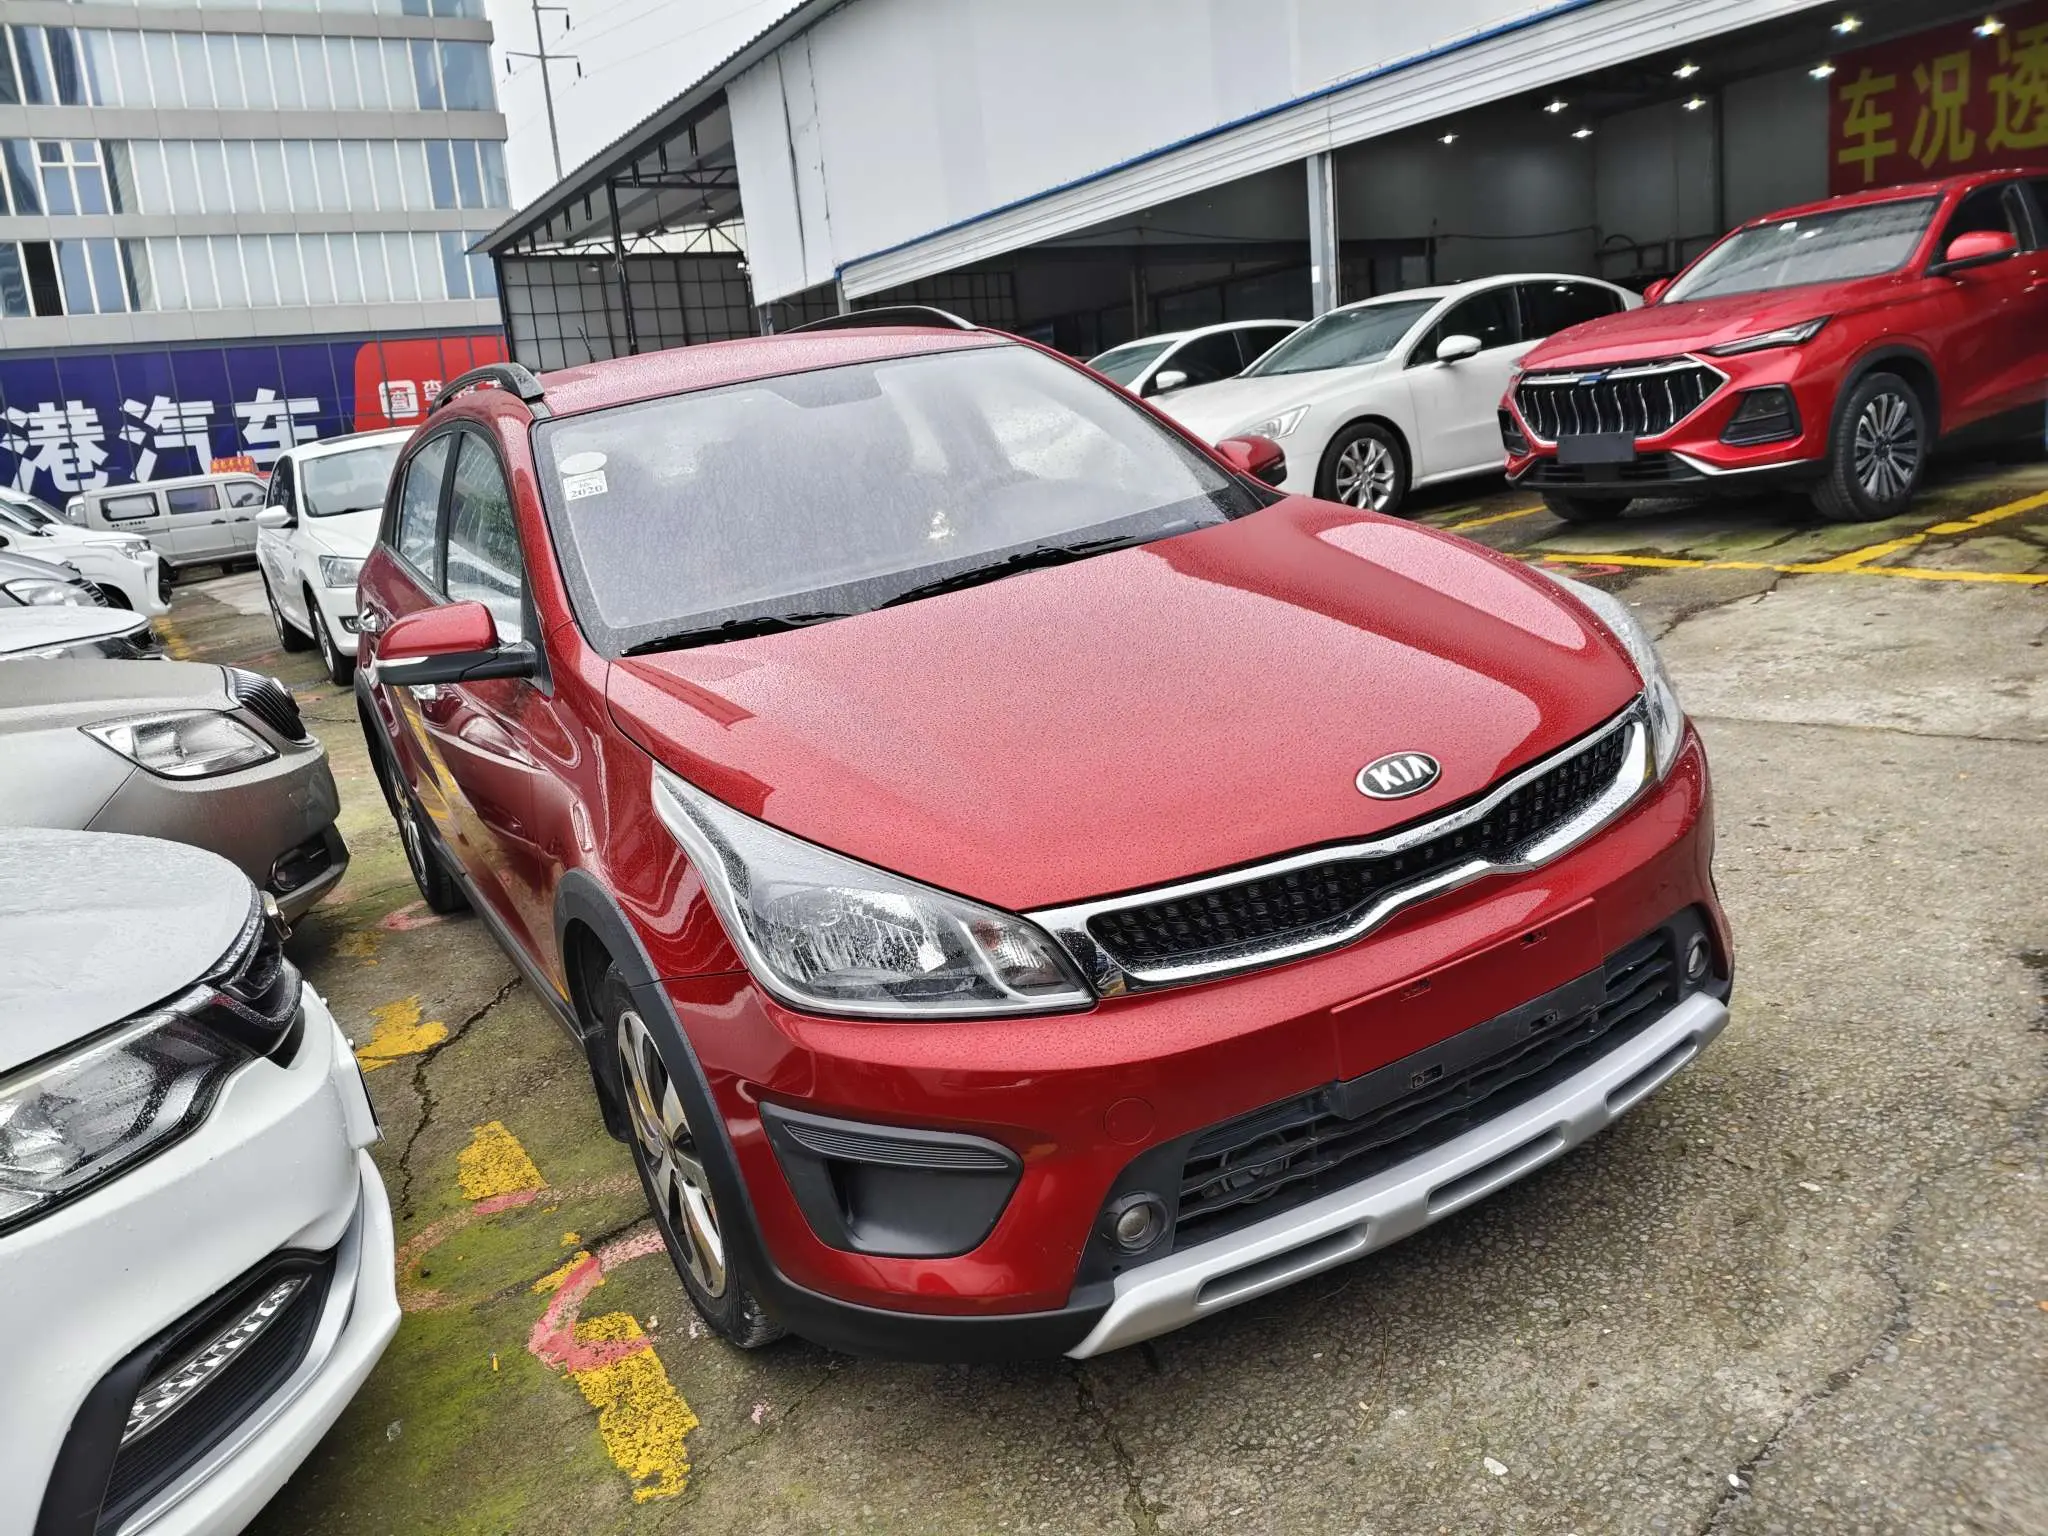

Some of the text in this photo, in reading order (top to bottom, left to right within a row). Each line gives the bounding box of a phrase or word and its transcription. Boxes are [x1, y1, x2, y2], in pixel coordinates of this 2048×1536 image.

[0, 388, 320, 494] 港汽车
[1367, 755, 1435, 792] KIA
